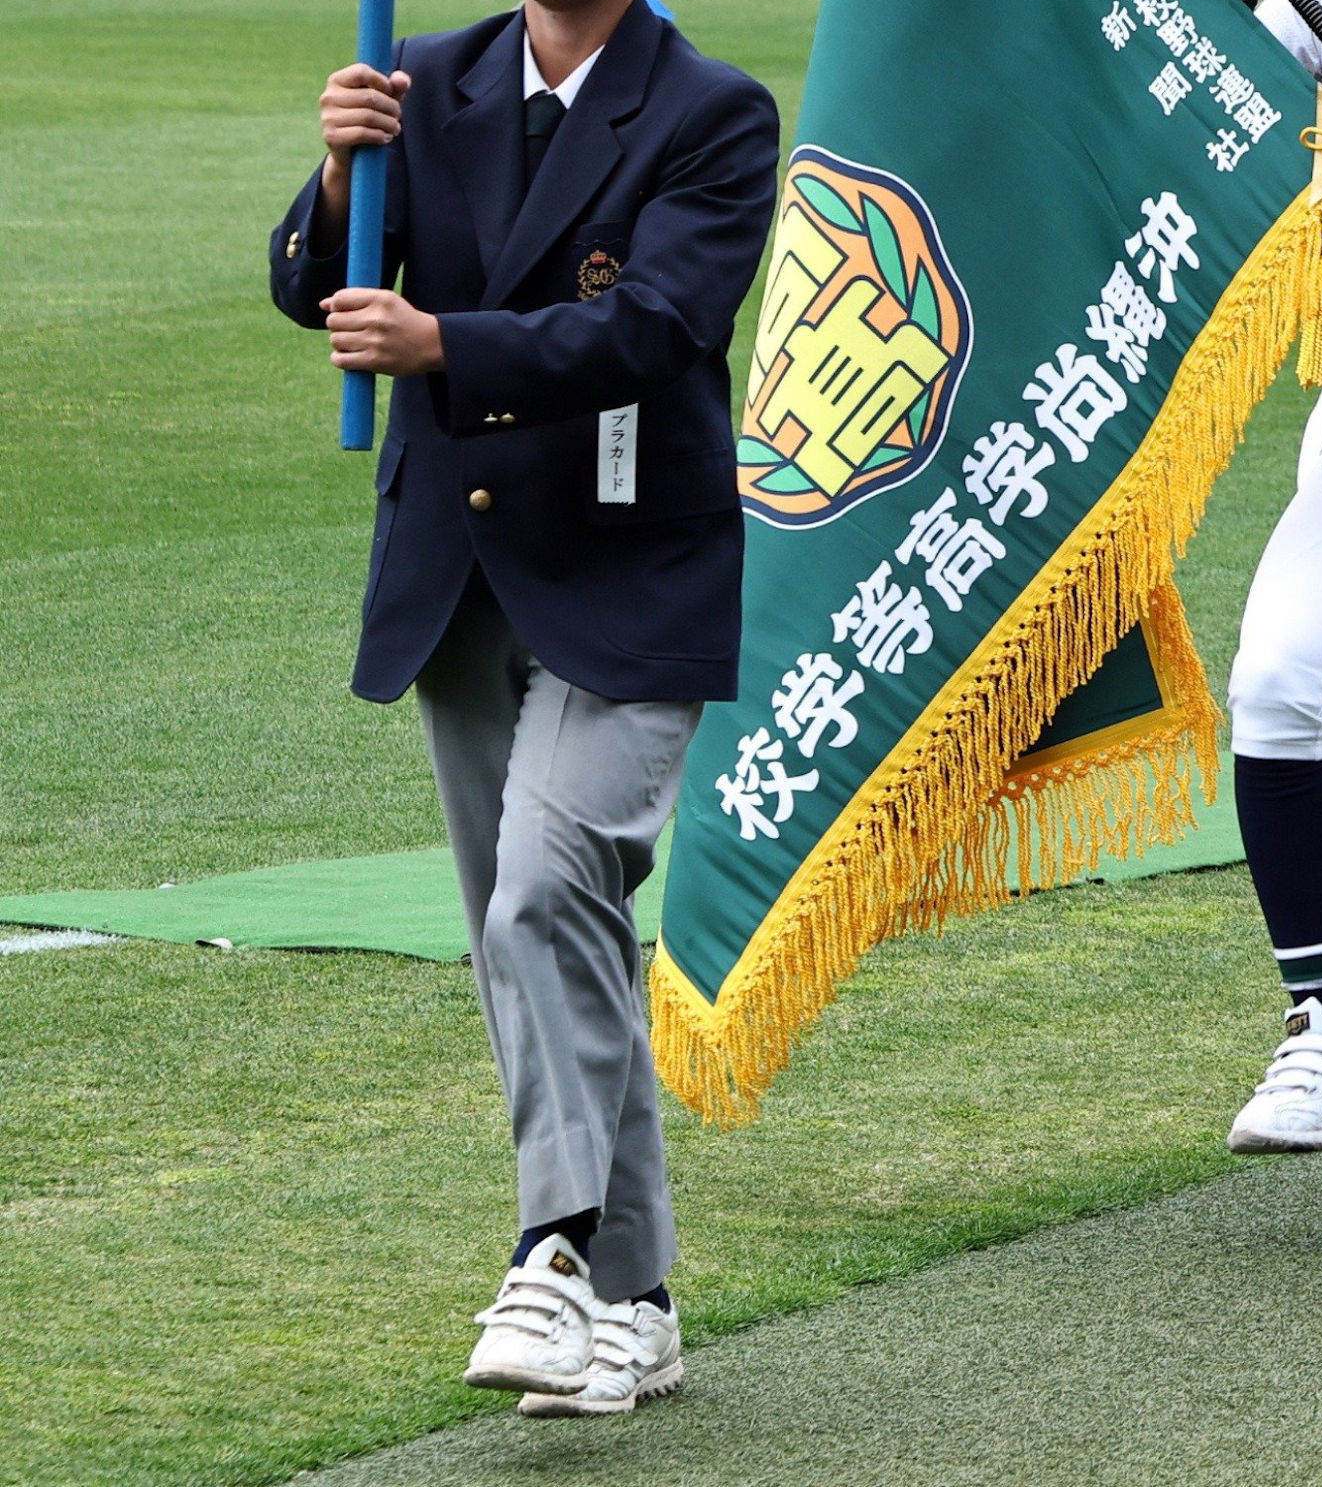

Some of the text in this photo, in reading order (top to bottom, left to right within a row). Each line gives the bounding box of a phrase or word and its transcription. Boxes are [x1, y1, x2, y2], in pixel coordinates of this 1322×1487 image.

[609, 413, 628, 492] プラカード
[715, 191, 1201, 842] 沖縄尚学高等学校
